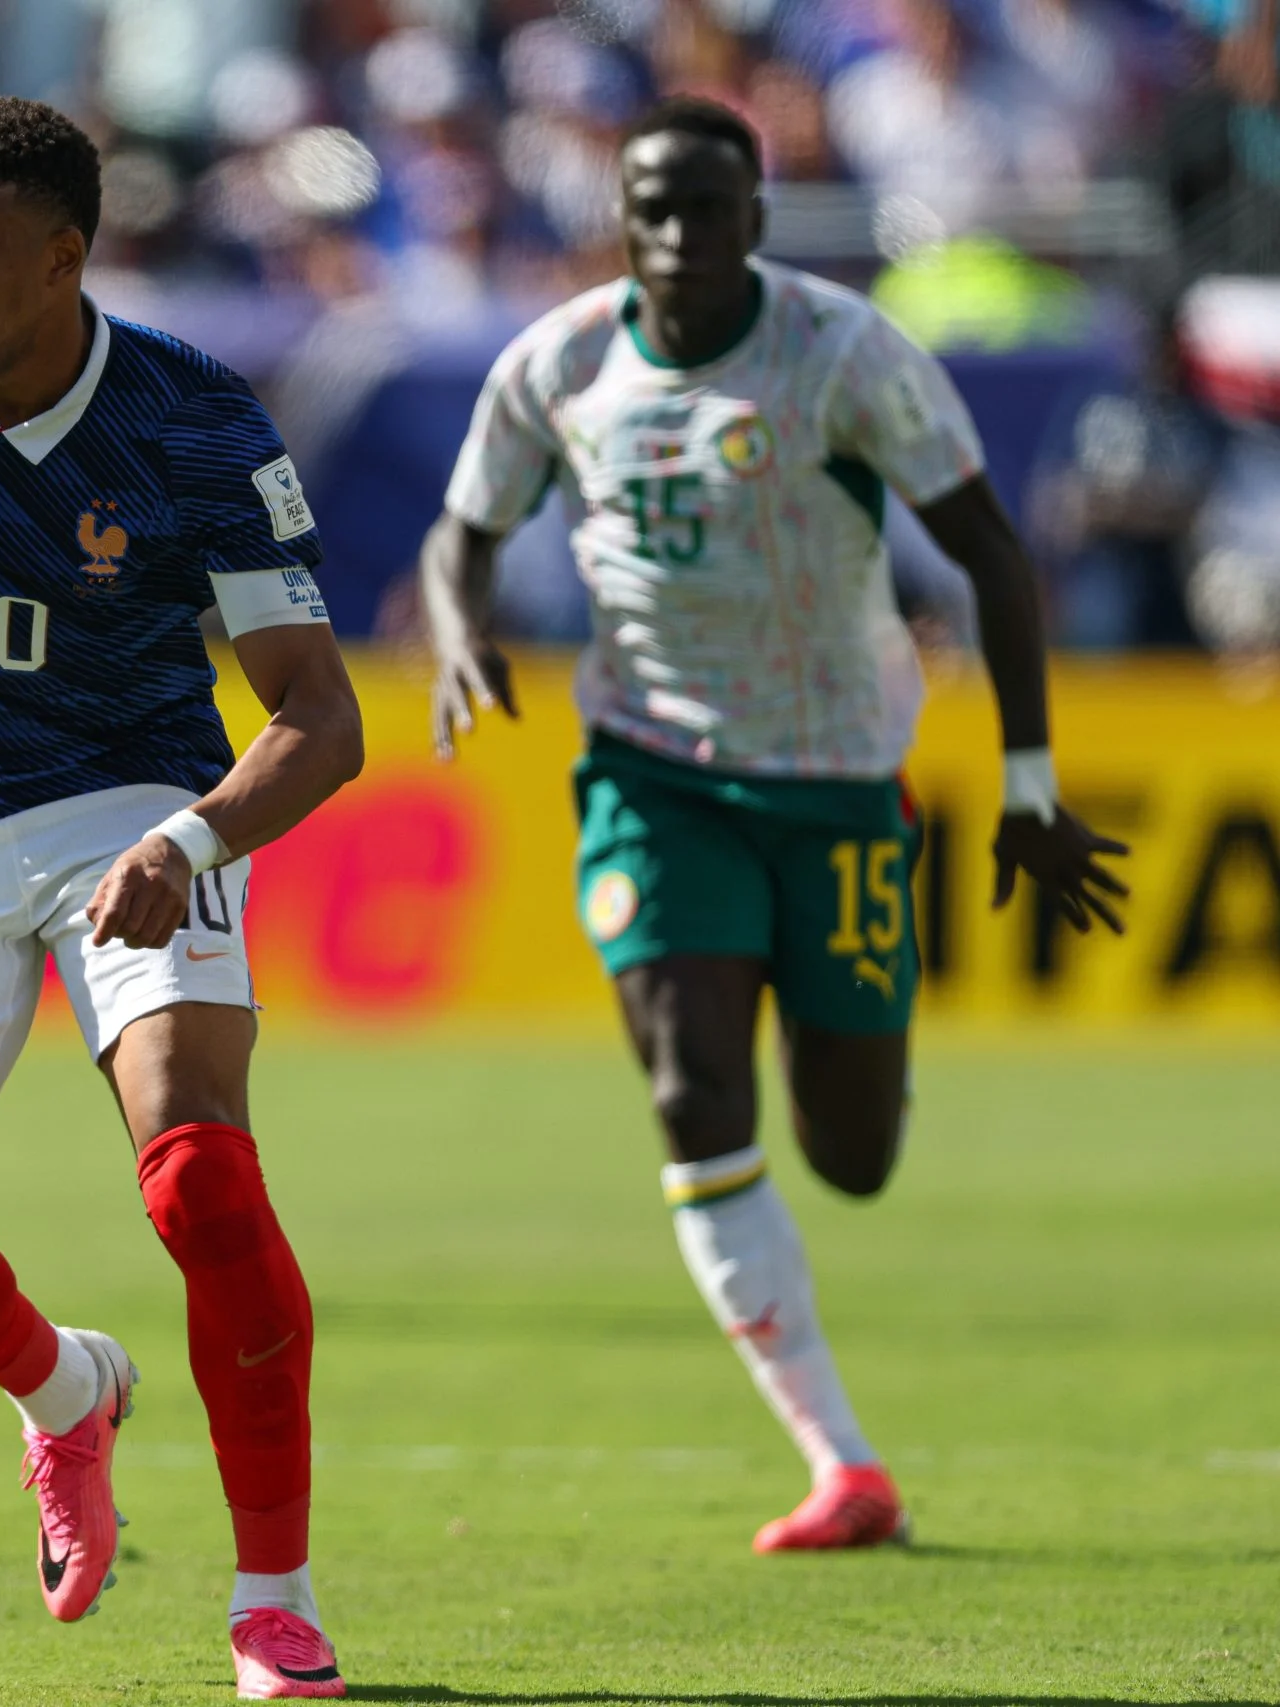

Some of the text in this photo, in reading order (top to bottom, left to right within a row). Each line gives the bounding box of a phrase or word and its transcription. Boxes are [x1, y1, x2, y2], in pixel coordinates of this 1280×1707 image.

[623, 472, 706, 563] 15
[286, 588, 308, 604] the
[827, 840, 904, 956] 15
